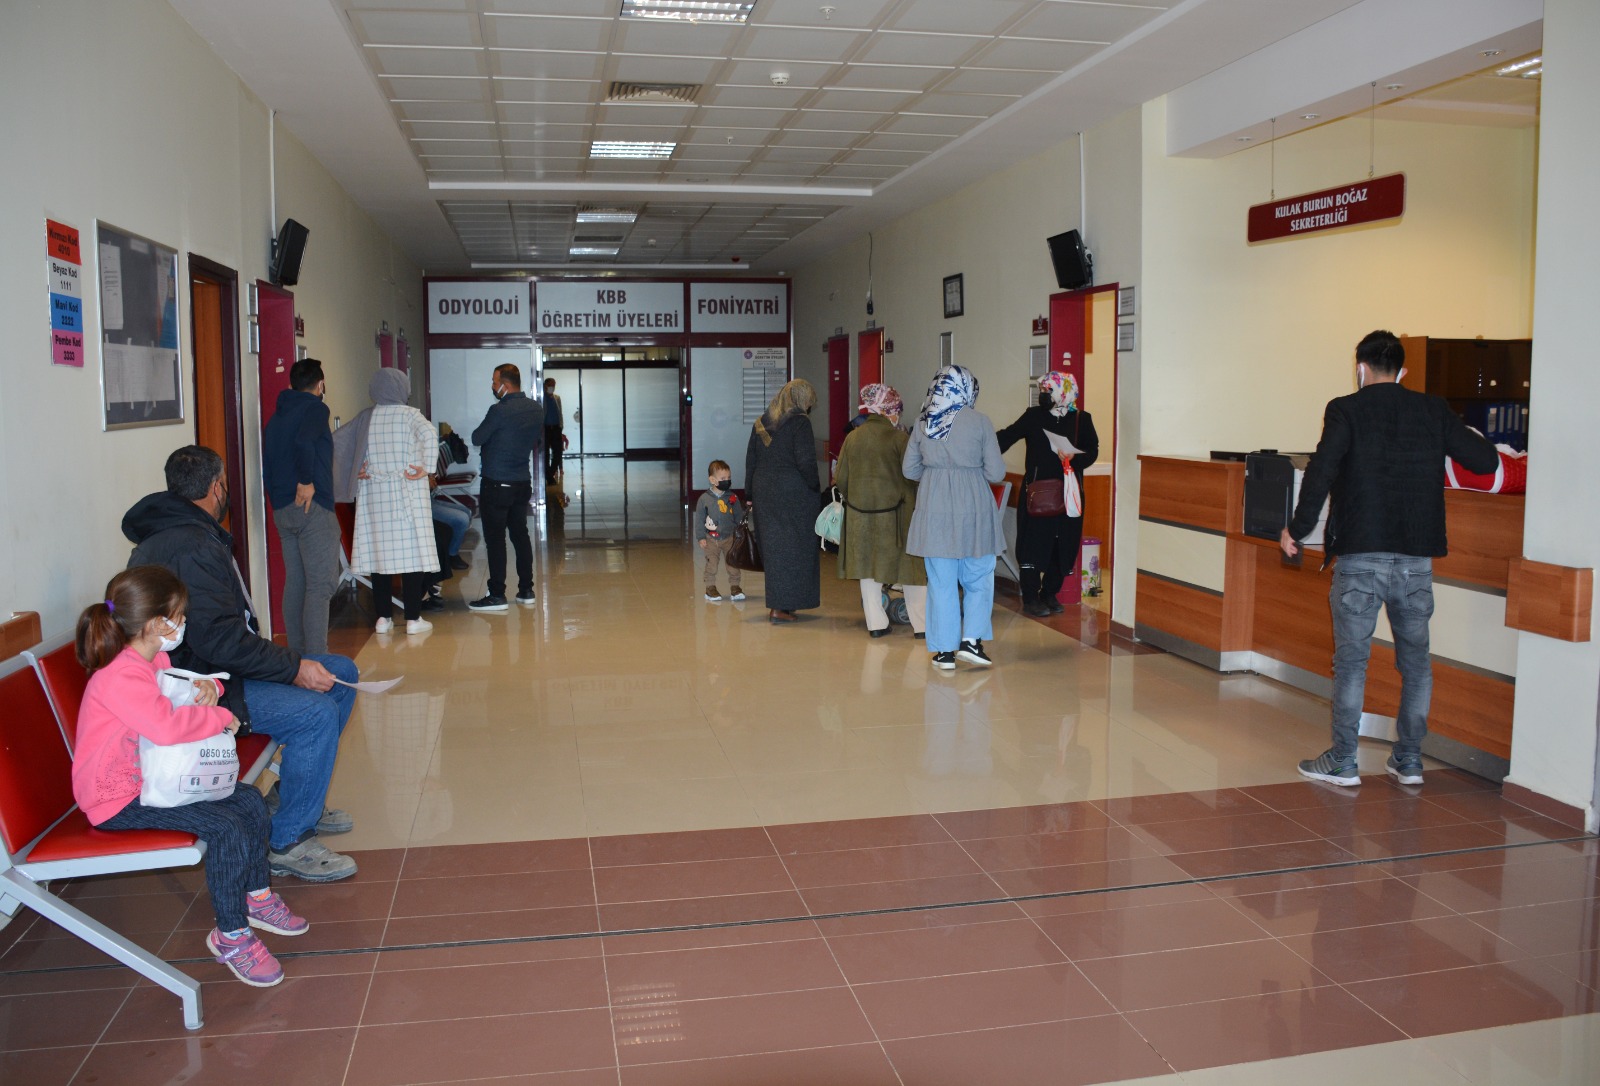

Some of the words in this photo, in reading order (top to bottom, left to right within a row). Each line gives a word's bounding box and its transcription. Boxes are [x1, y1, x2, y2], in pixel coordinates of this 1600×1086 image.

[1275, 202, 1301, 218] KULAK
[1303, 196, 1334, 213] BURUN
[1335, 188, 1368, 207] BOĞAZ
[1290, 207, 1348, 232] SEKRETERLİĞİ
[52, 262, 68, 277] Beyaz
[68, 267, 78, 278] Kod
[60, 280, 72, 291] 1111
[597, 290, 627, 304] KBB
[55, 299, 68, 311] Mavi
[68, 302, 79, 313] Kod
[438, 295, 519, 315] ODYOLOJİ
[698, 295, 779, 315] FONİYATRİ
[61, 315, 74, 327] 2222
[542, 310, 611, 328] ÖĞRETİM
[617, 310, 679, 328] ÜYELERİ
[55, 334, 72, 346] Pembe
[72, 337, 82, 348] Kod
[63, 350, 75, 361] 3333
[200, 748, 221, 758] 0850
